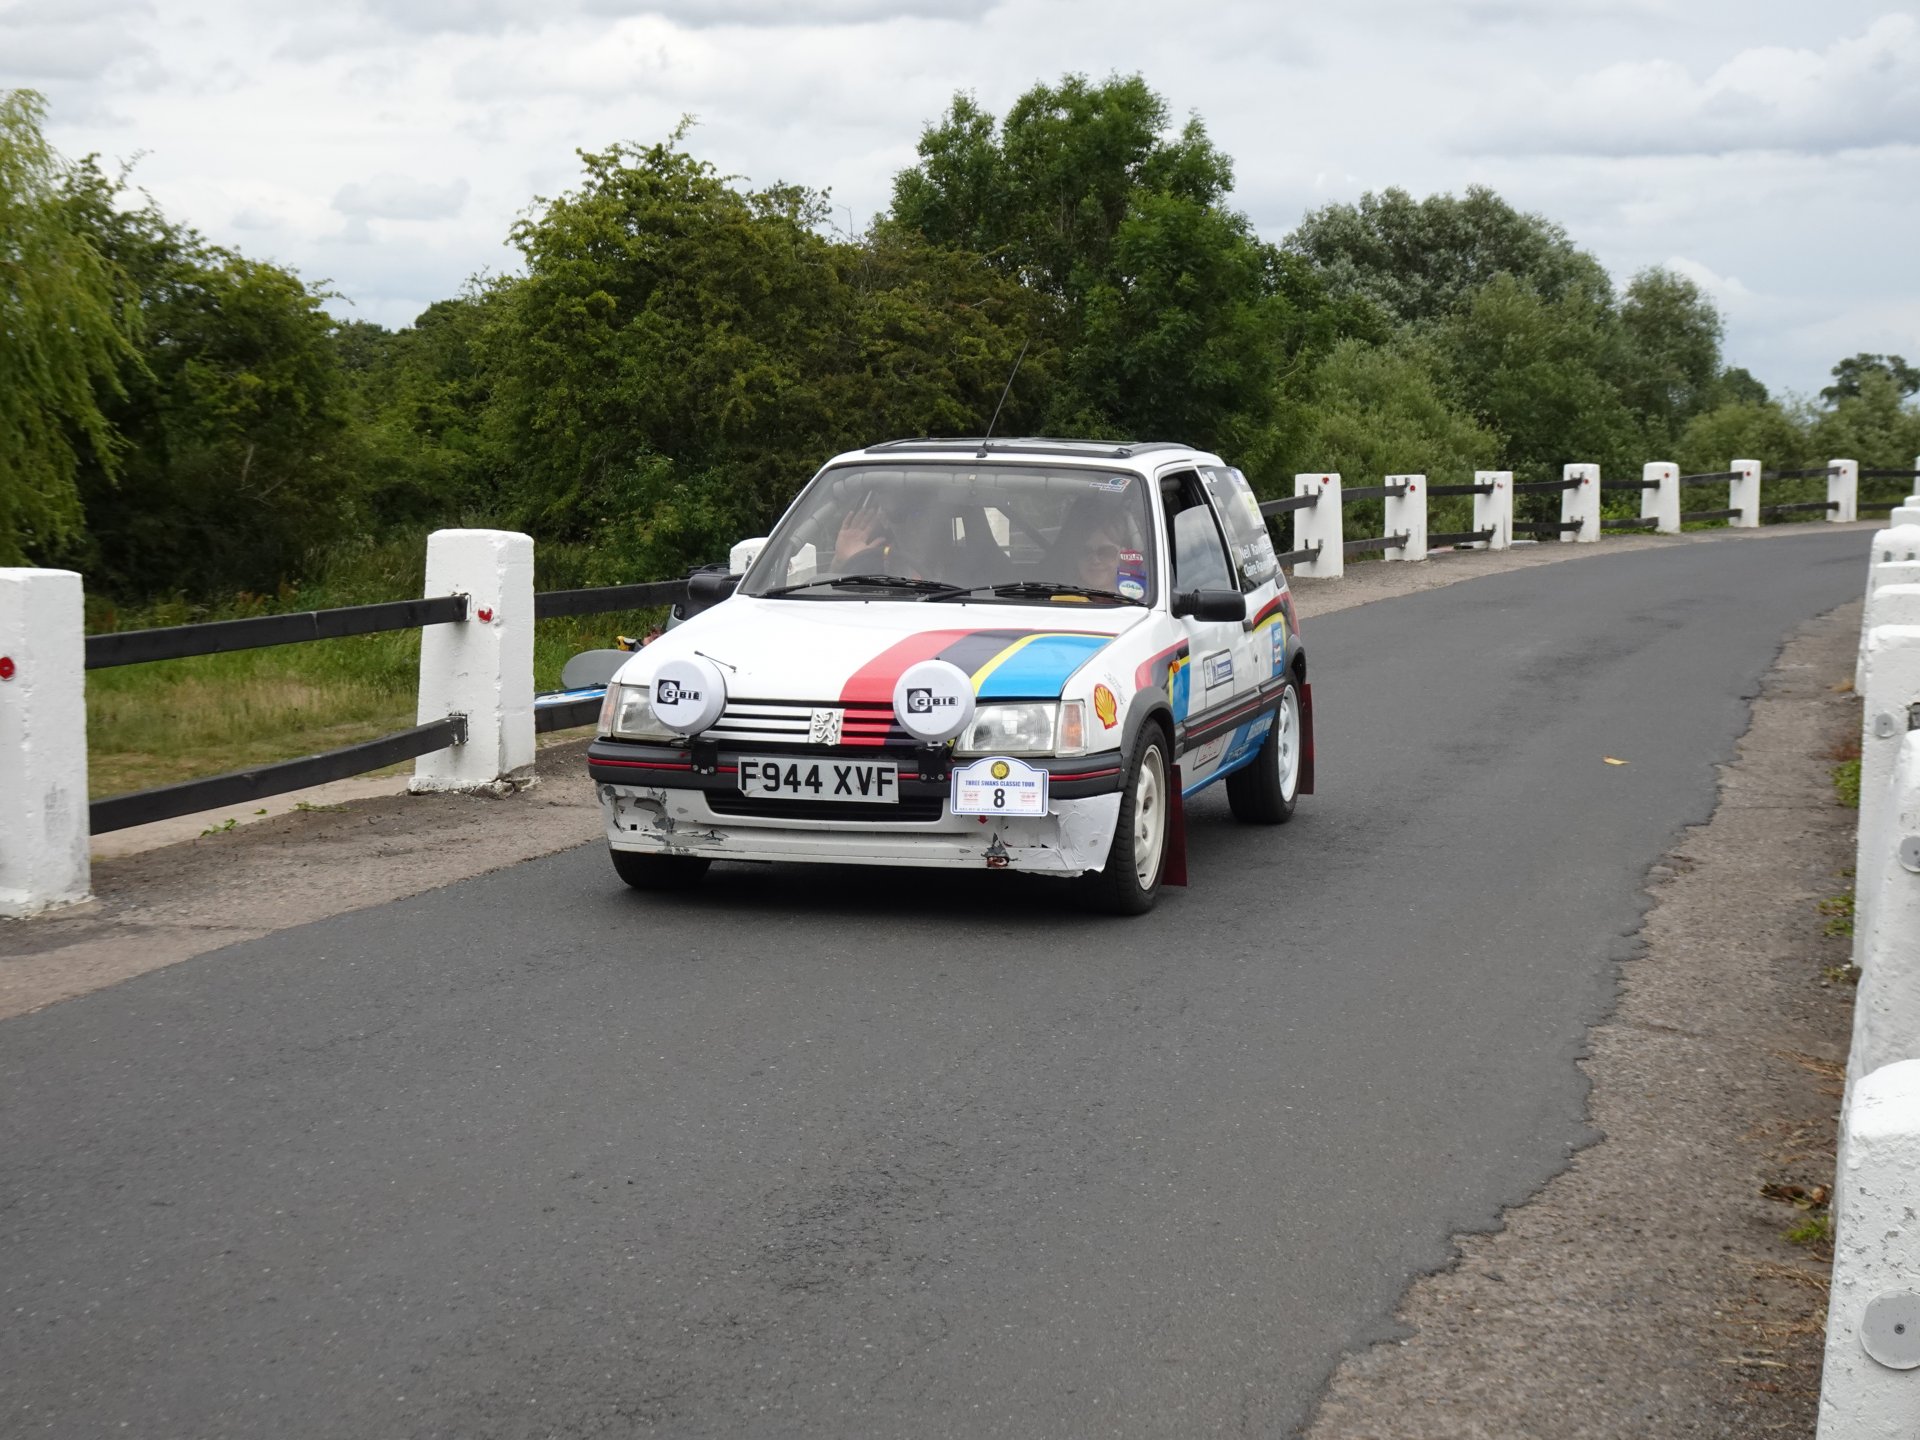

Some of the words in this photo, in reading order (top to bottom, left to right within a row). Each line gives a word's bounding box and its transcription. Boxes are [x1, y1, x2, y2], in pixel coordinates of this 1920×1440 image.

[740, 762, 823, 794] F944
[833, 765, 895, 796] XVF
[994, 788, 1005, 808] 8
